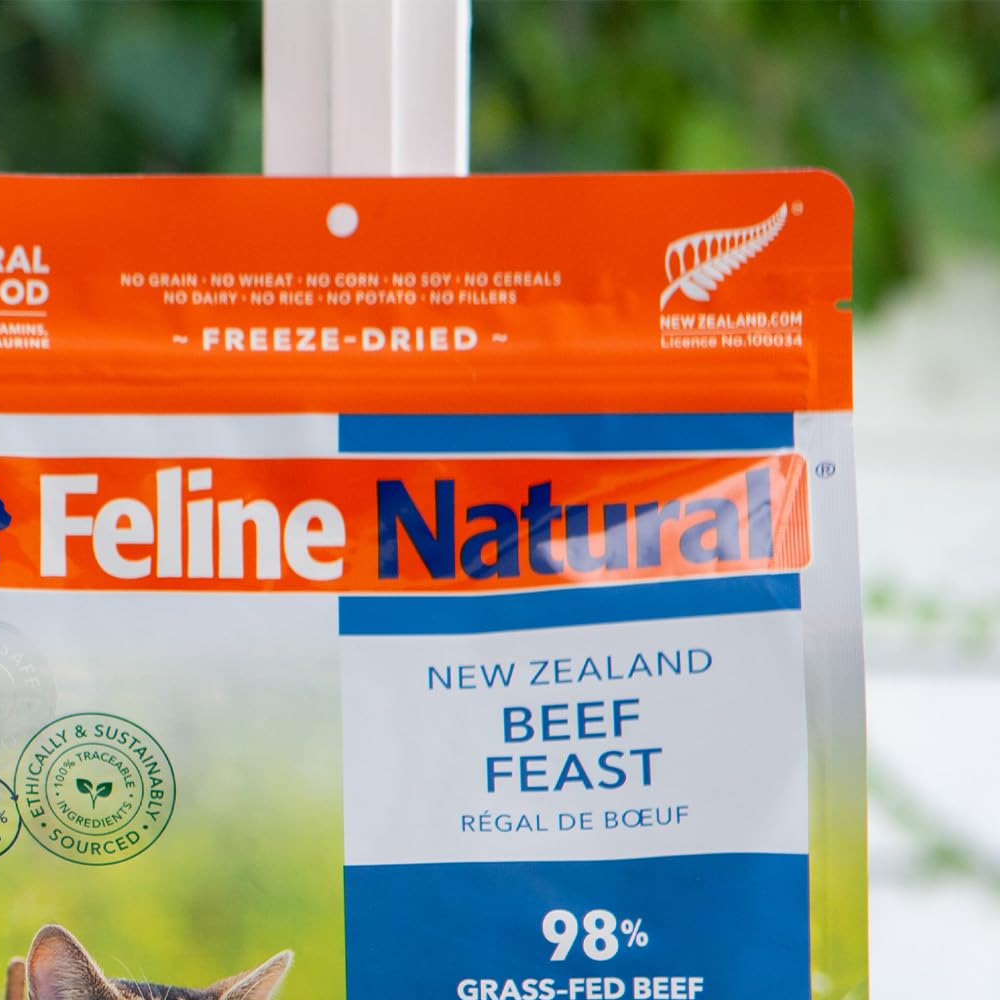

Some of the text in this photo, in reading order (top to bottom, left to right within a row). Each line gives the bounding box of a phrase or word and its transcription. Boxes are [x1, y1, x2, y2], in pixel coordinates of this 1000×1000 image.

[120, 271, 562, 287] NO GRAIN NO WHEAT NO CORN NO SOY NO CEREALS
[164, 290, 518, 305] NO DAIRY NO RICE NO POTATO NO FILLERS
[202, 326, 478, 352] FREEZE-DRIED
[661, 335, 718, 349] Licence
[38, 467, 775, 582] Feline Natural
[427, 648, 713, 690] NEW ZEALAND
[502, 698, 640, 743] BEEF
[25, 724, 164, 822] ETHICALLY & SUSTAINABLY
[54, 751, 135, 789] 100% TRACEABLE
[486, 747, 663, 793] FEAST
[56, 800, 132, 829] INGREDIENTS
[461, 806, 690, 833] RÉGAL DE BŒUF
[48, 828, 140, 855] SOURCED
[541, 908, 649, 961] 98%
[633, 976, 704, 1000] BEEF
